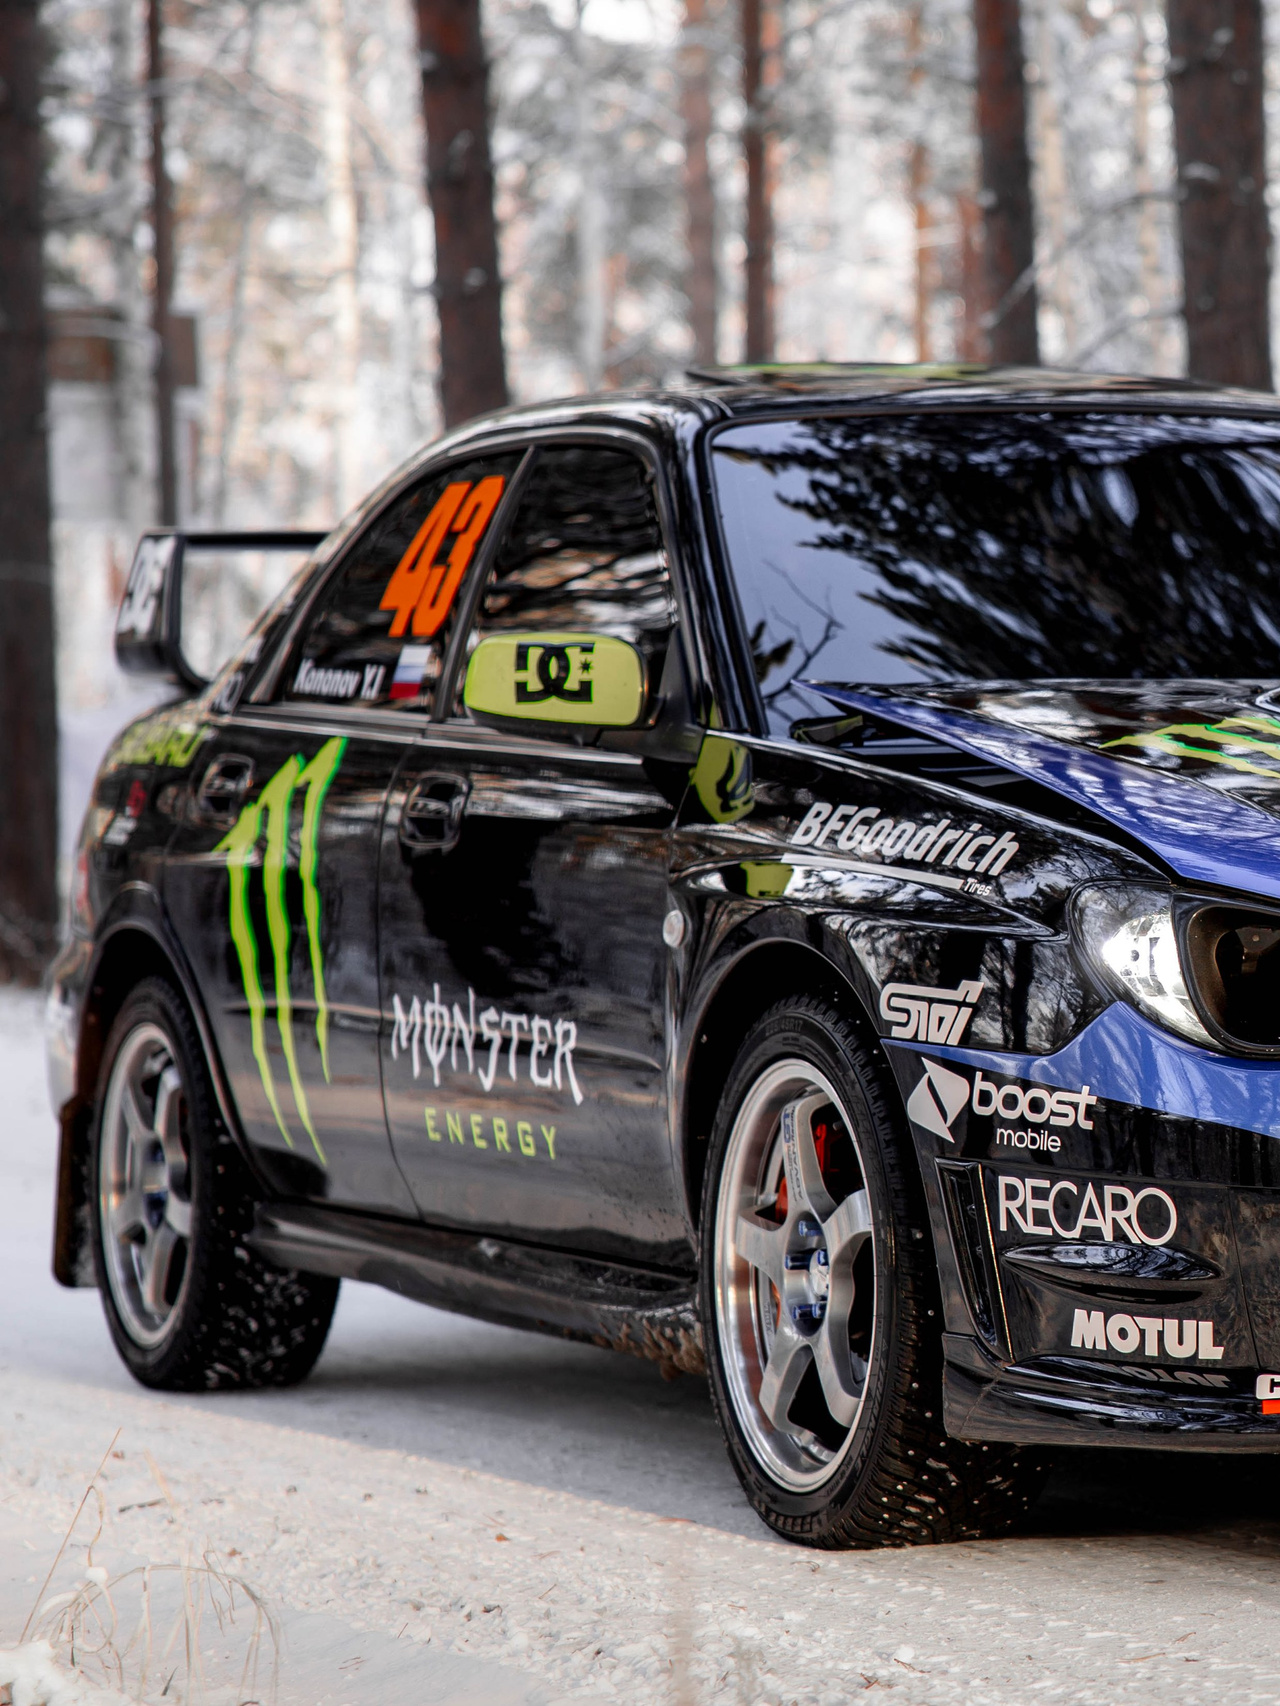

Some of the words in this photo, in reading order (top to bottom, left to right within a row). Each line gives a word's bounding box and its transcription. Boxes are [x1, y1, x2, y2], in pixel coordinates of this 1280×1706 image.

[379, 475, 505, 638] 43
[791, 802, 1020, 876] BFGoodrich
[963, 877, 992, 897] Tires
[391, 982, 584, 1106] MONSTER
[972, 1071, 1098, 1130] boost
[425, 1107, 557, 1160] ENERGY
[996, 1128, 1062, 1153] mobile
[998, 1175, 1178, 1246] RECARO
[1070, 1308, 1225, 1360] MOTUL
